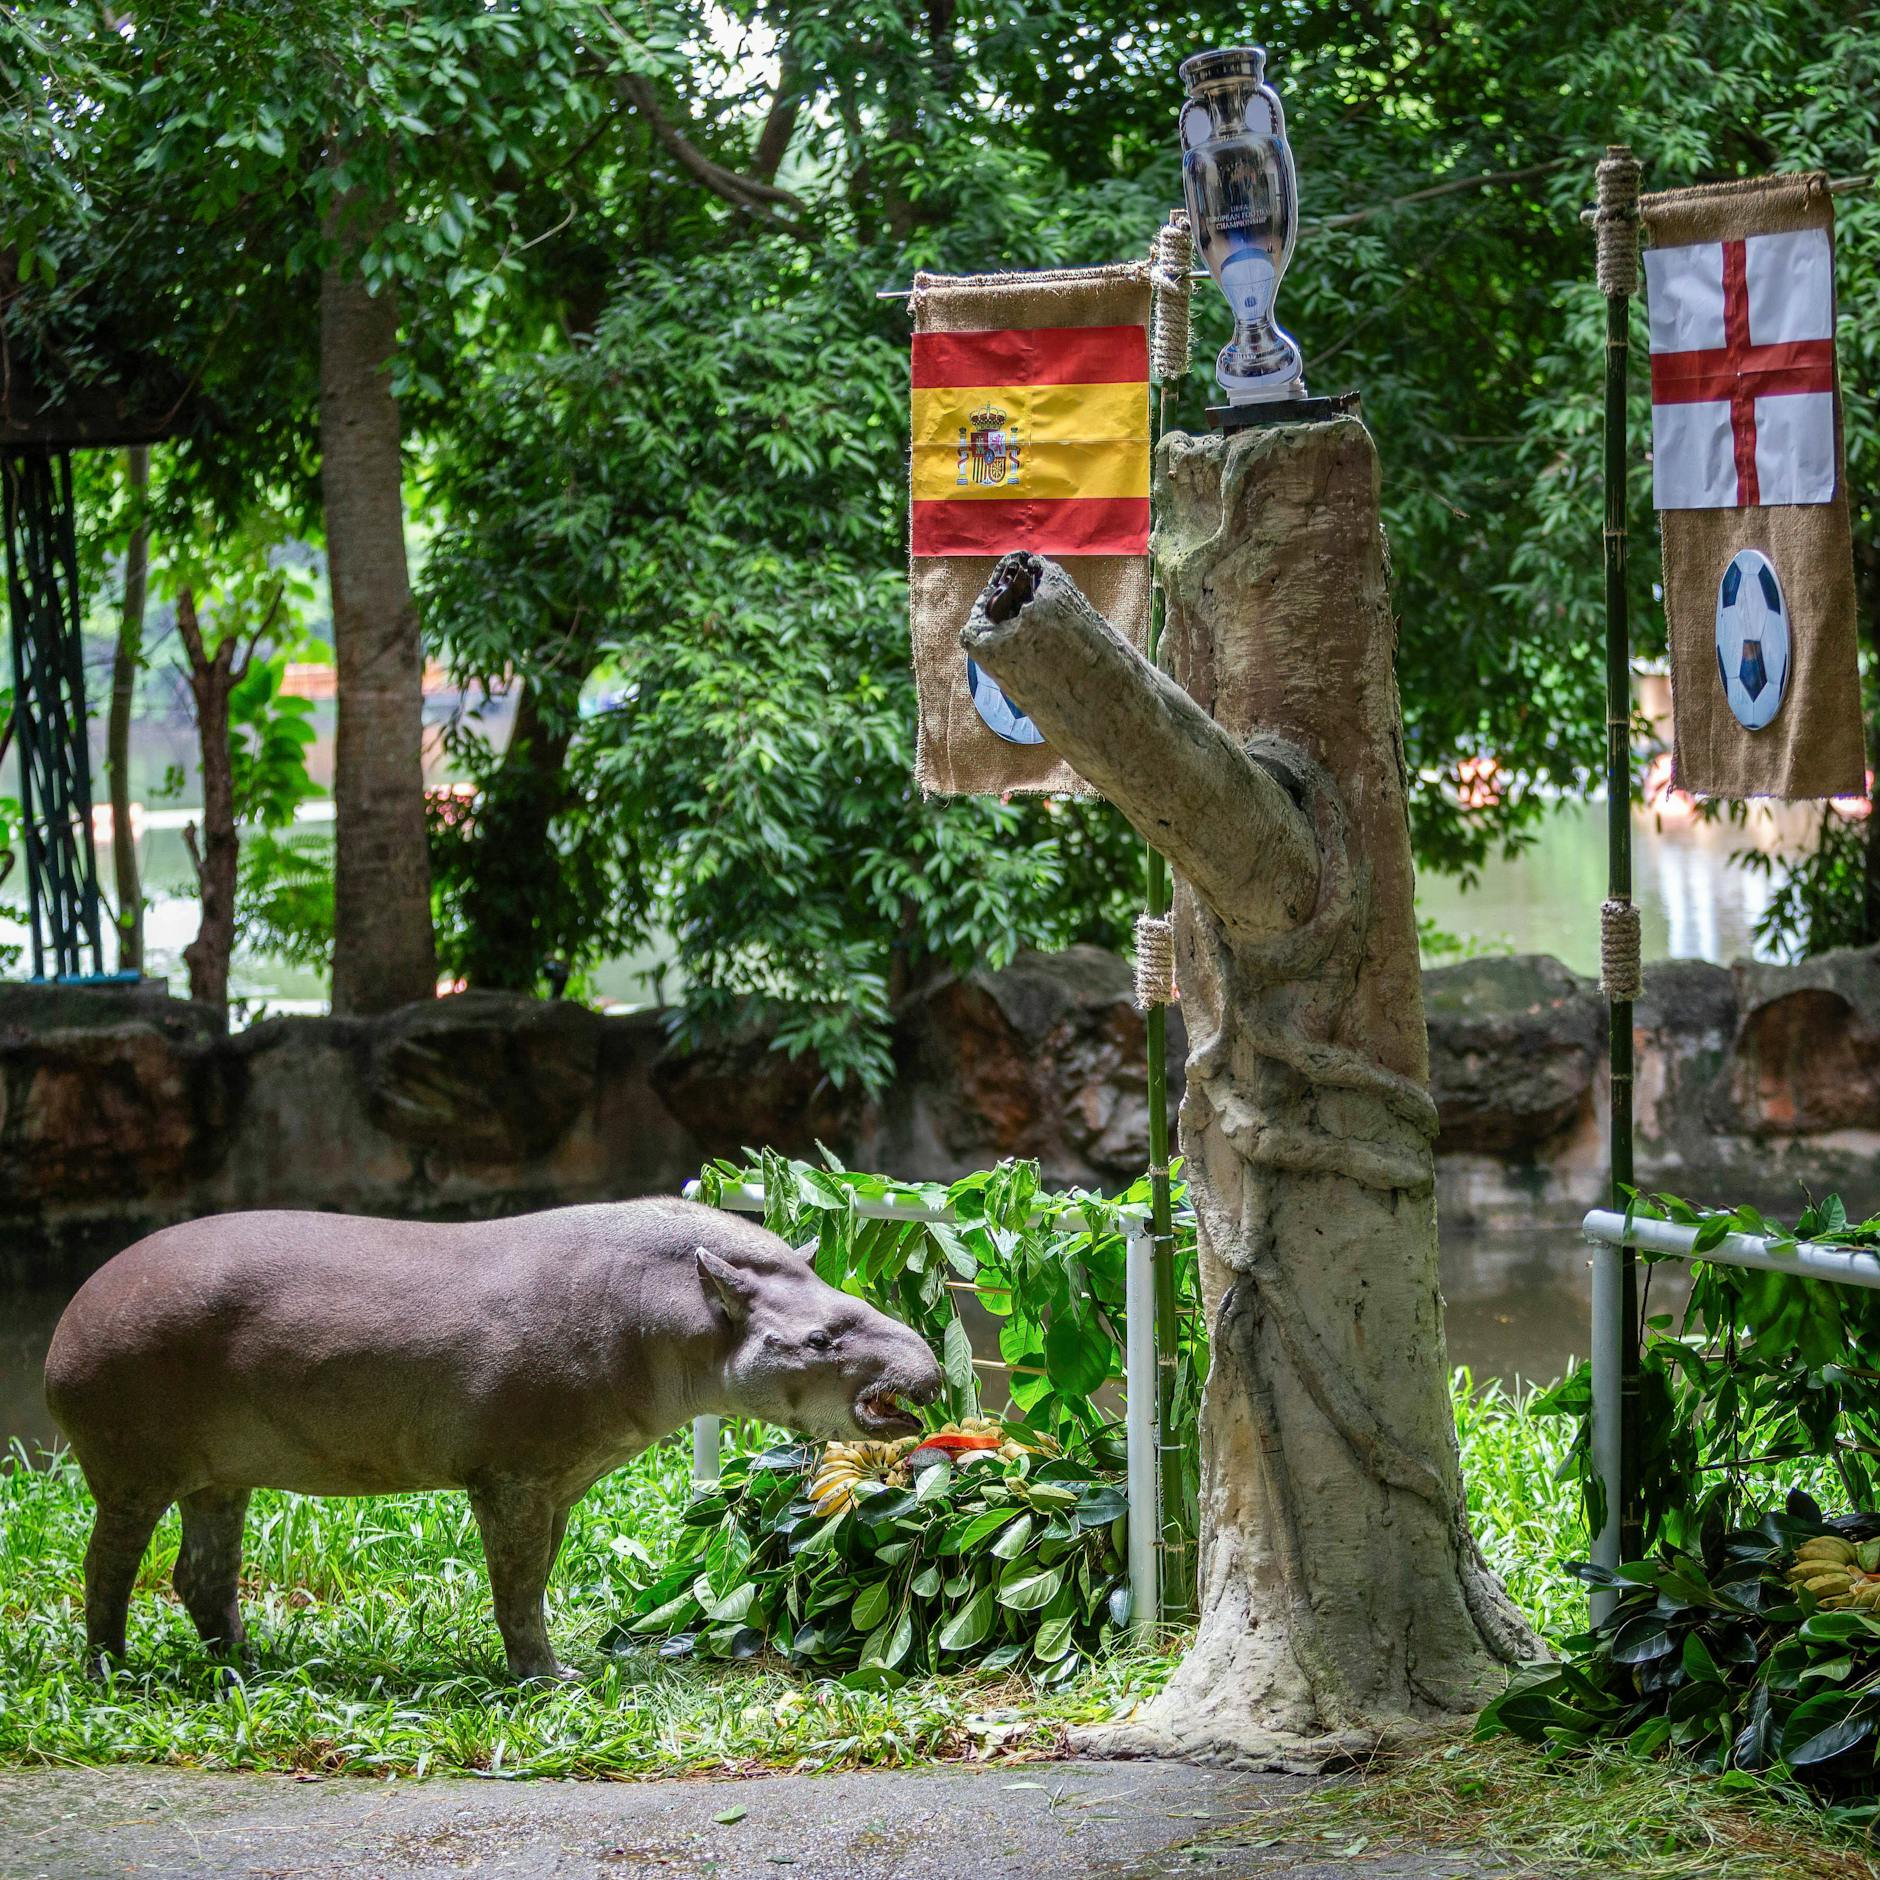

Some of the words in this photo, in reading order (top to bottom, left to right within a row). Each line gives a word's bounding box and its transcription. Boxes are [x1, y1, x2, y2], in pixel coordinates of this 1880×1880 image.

[1230, 204, 1248, 213] UEFA
[1241, 207, 1274, 218] FOOTBA
[1216, 216, 1267, 230] CHAMPIONSHIP
